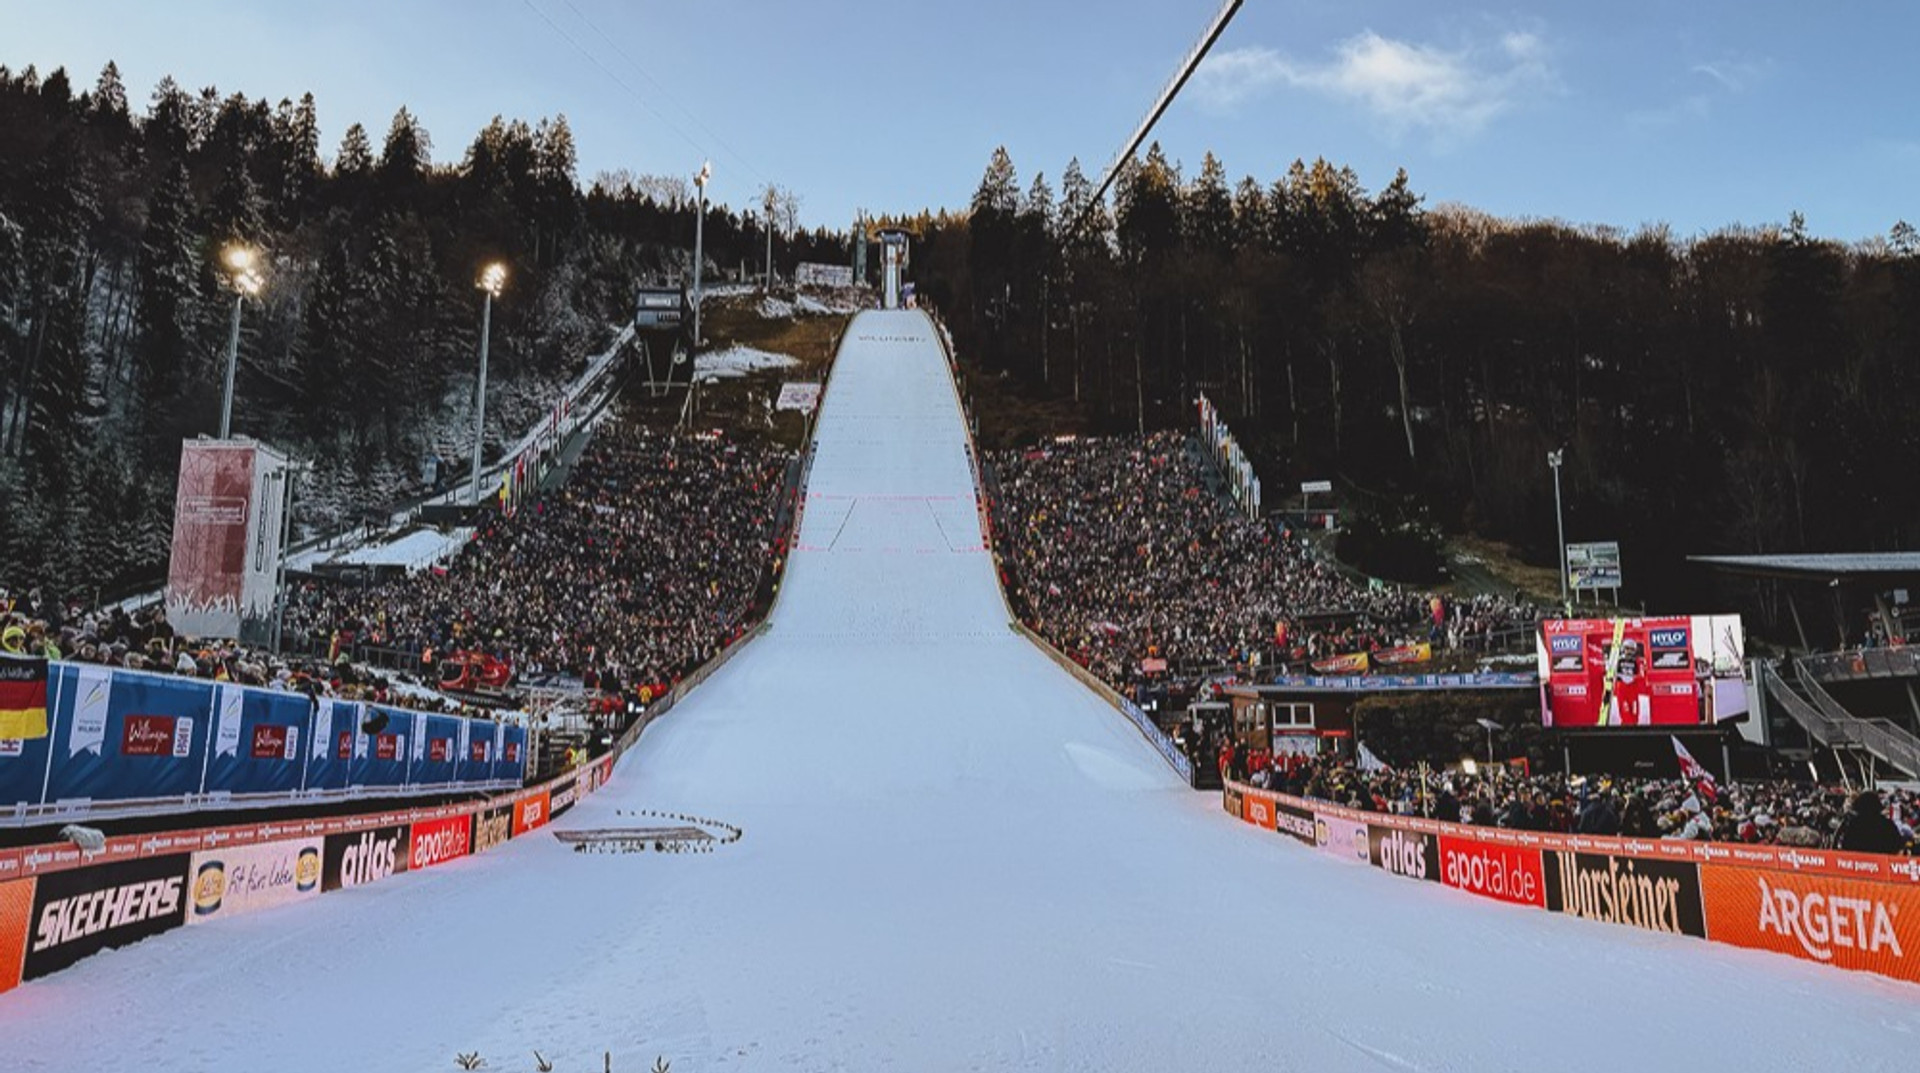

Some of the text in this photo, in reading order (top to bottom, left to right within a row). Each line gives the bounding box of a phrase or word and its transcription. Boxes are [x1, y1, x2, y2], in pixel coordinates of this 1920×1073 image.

[340, 829, 396, 888] atlas
[414, 822, 466, 867] apotal.de
[1380, 829, 1426, 879] atlas
[1447, 849, 1535, 902] apotal.de
[1556, 851, 1683, 936] Warsteiner
[33, 876, 183, 952] SKECHERS
[1758, 876, 1903, 960] ARGETA
